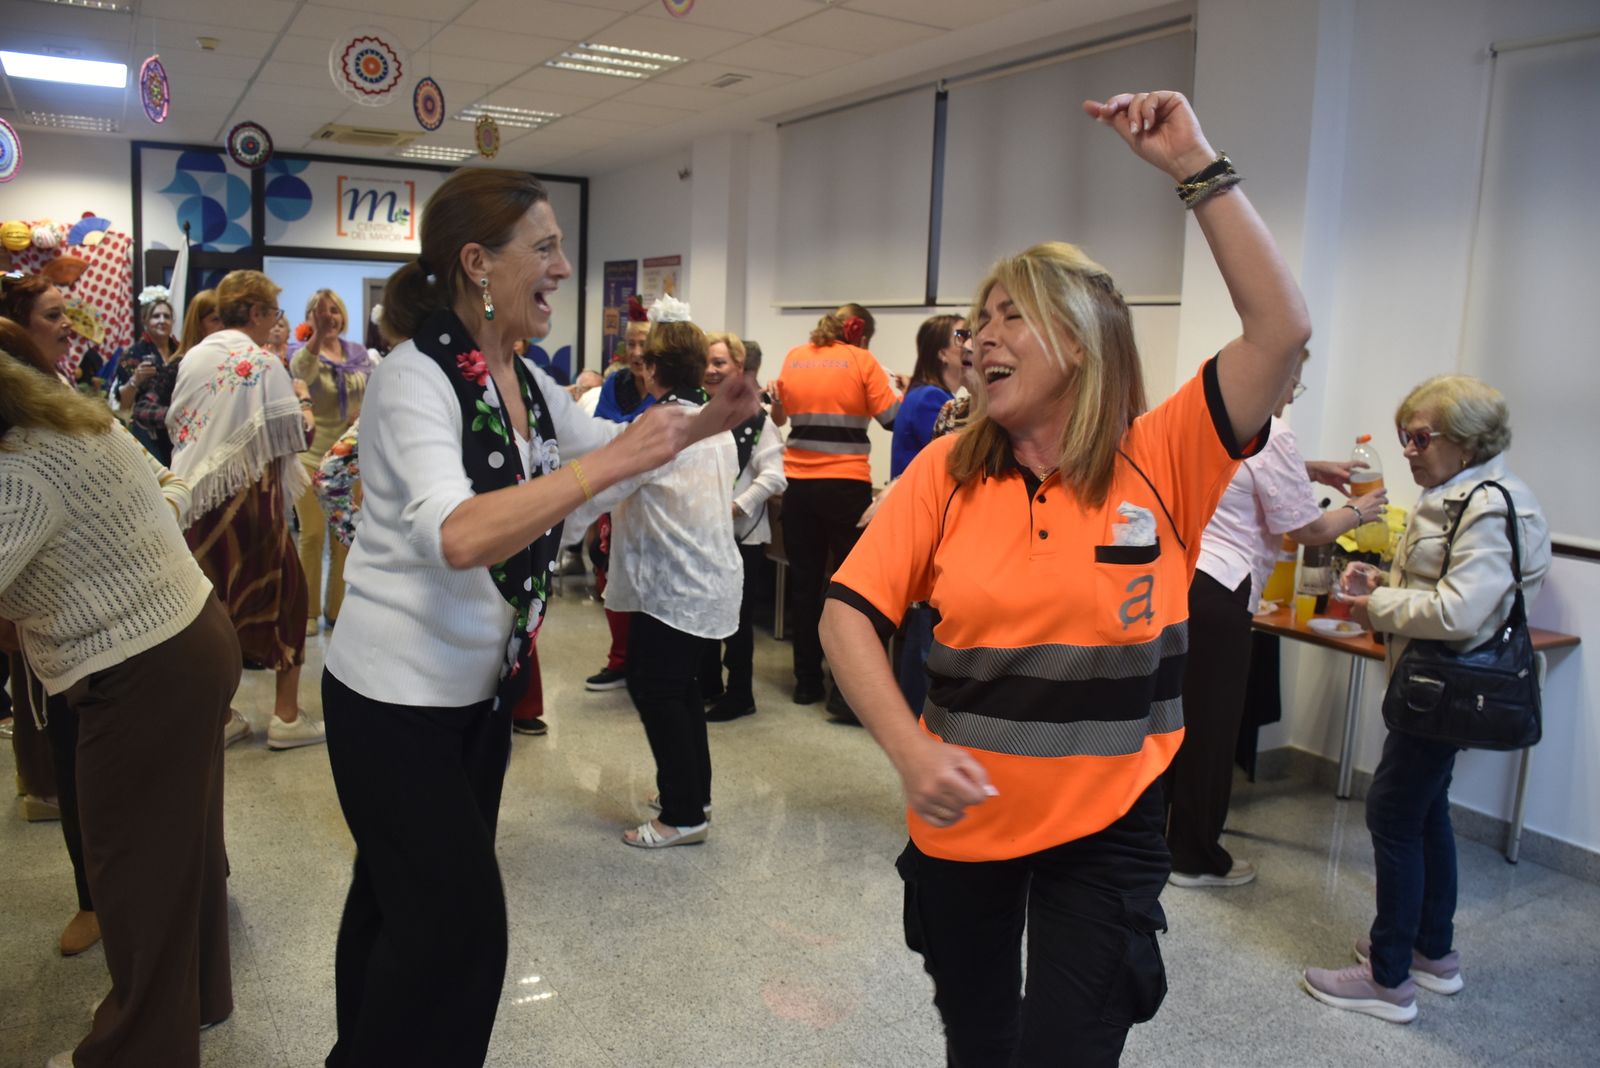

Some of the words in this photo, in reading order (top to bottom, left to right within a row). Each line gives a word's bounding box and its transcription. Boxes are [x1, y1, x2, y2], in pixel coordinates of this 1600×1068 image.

[357, 222, 393, 232] CENTRO
[352, 231, 366, 240] DEL
[369, 232, 401, 241] MAYOR
